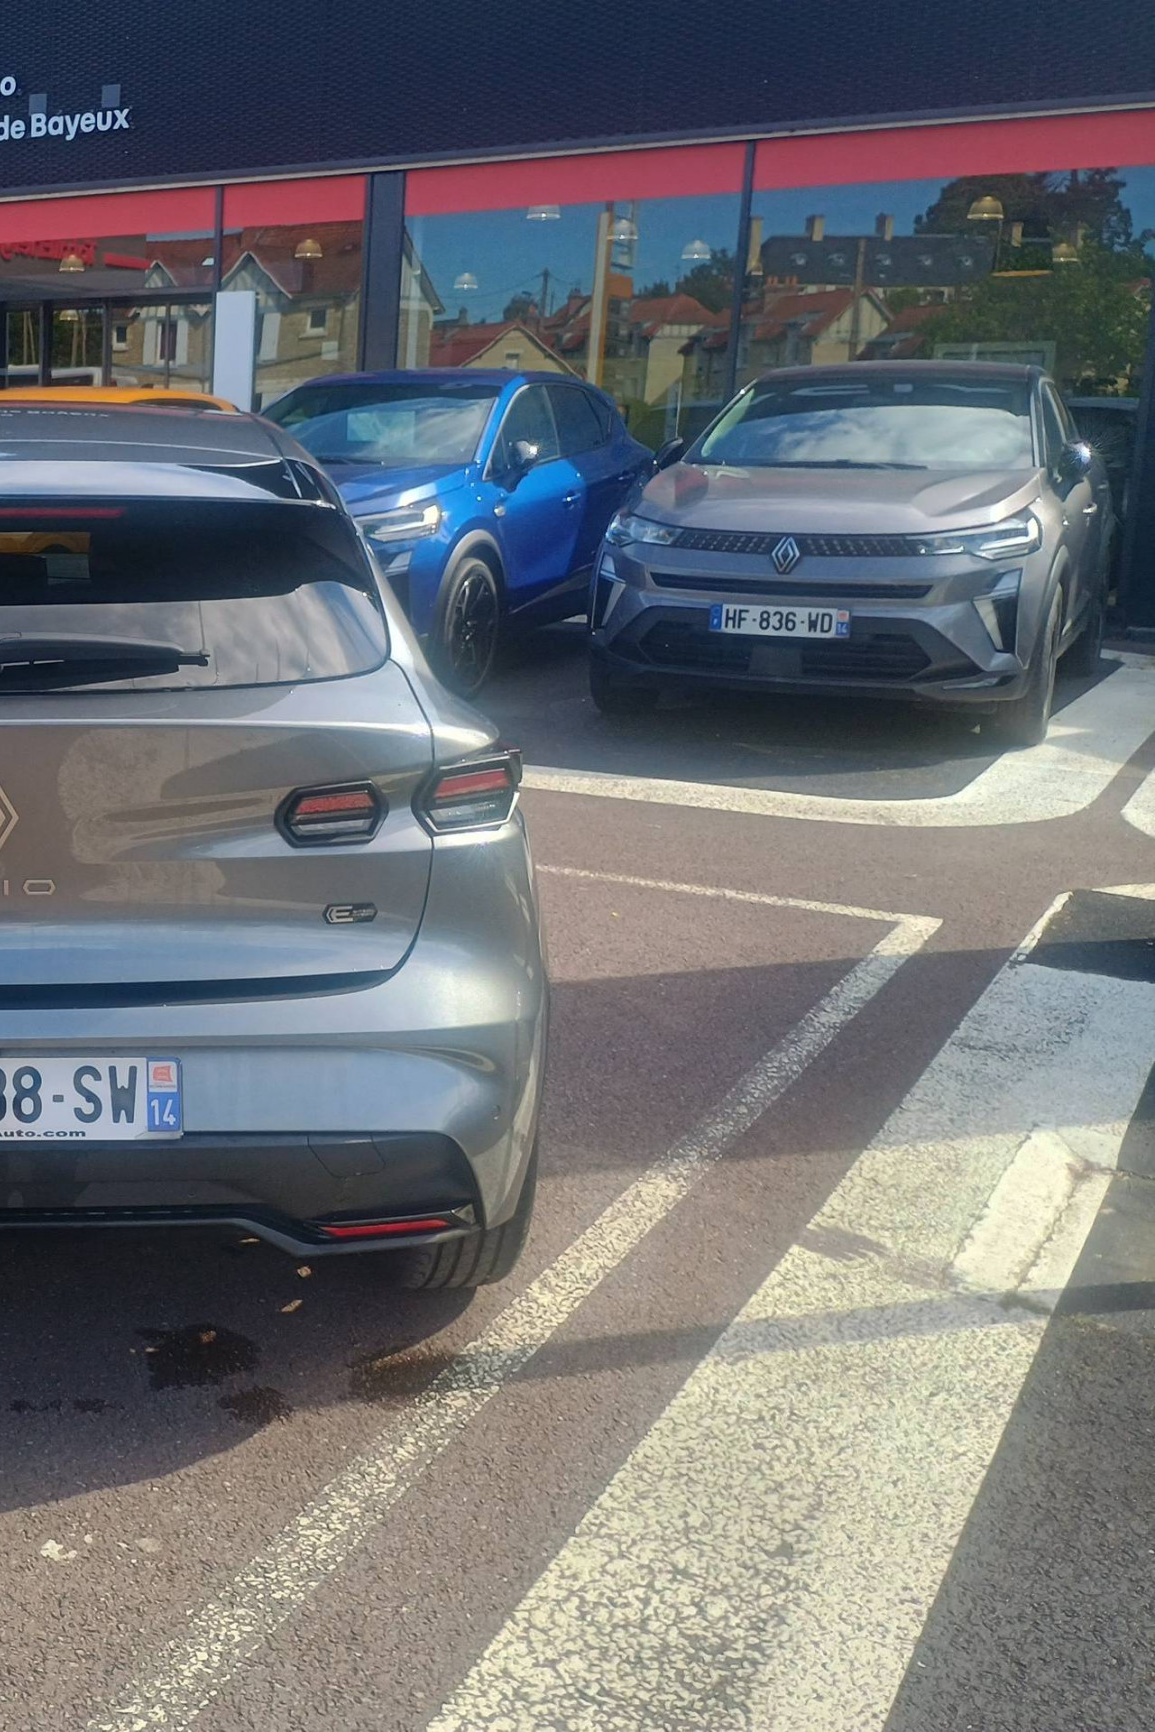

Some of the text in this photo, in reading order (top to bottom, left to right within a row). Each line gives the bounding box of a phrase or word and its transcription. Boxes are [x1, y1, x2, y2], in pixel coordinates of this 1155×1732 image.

[30, 108, 130, 140] Bayeux
[724, 608, 833, 633] HF-836-WD
[150, 1098, 177, 1126] 14
